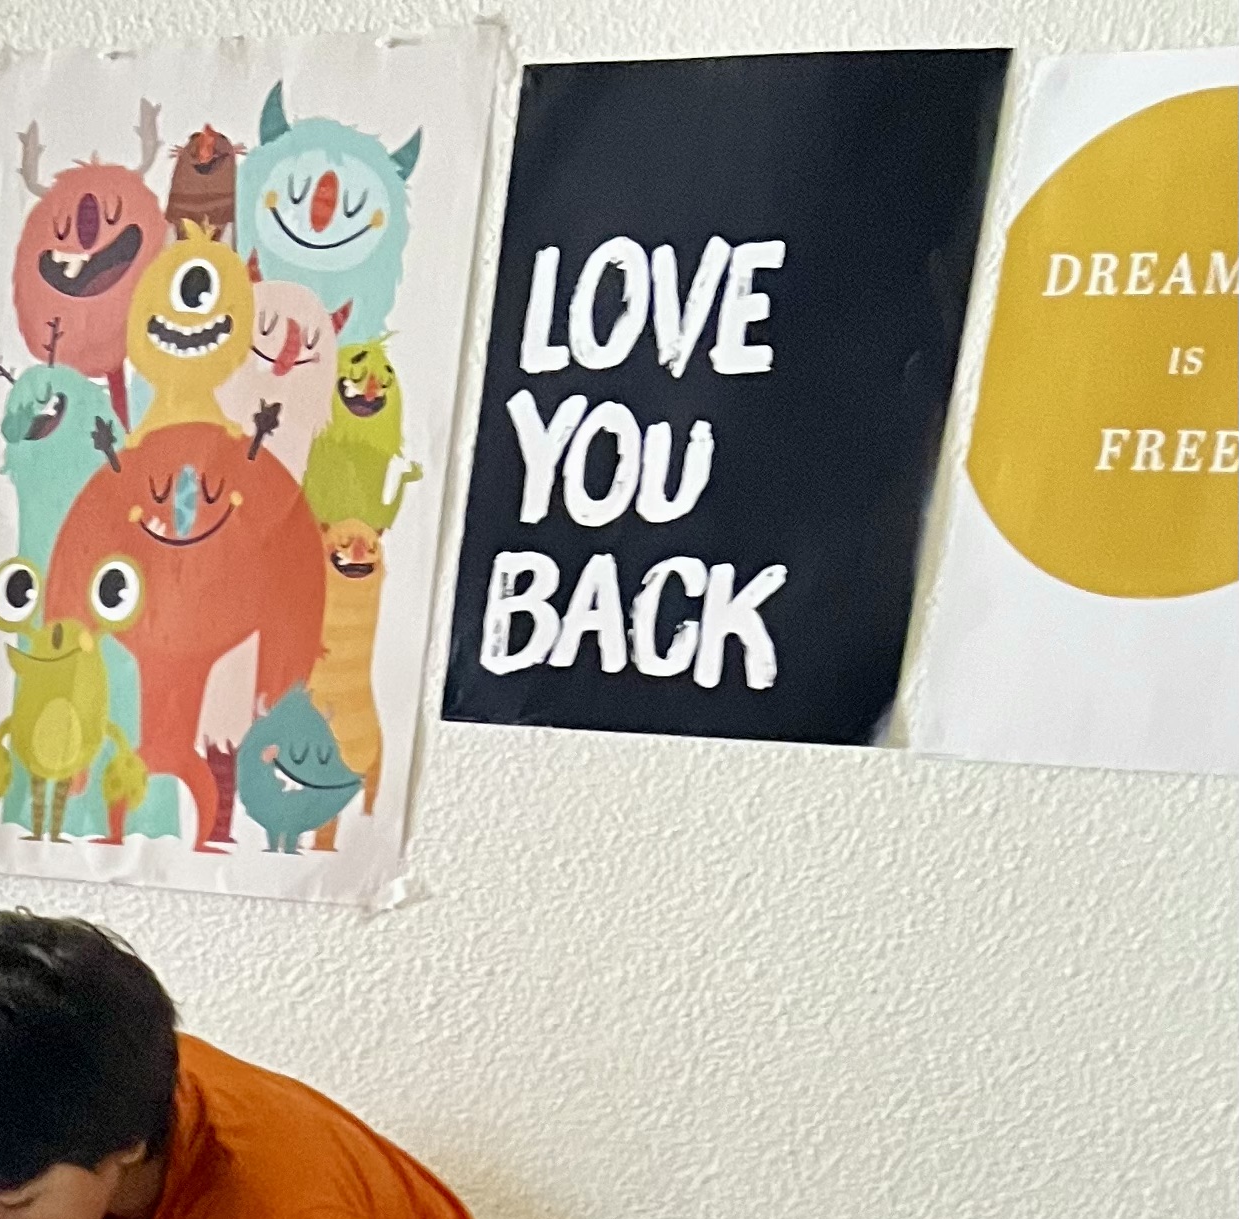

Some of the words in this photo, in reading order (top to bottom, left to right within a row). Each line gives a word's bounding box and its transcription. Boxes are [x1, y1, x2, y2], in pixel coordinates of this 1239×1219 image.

[519, 235, 787, 378] LOVE
[1041, 251, 1239, 297] DREAM
[1168, 347, 1204, 375] IS
[505, 389, 715, 527] YOU
[1094, 428, 1239, 473] FREE
[479, 550, 788, 689] BACK
